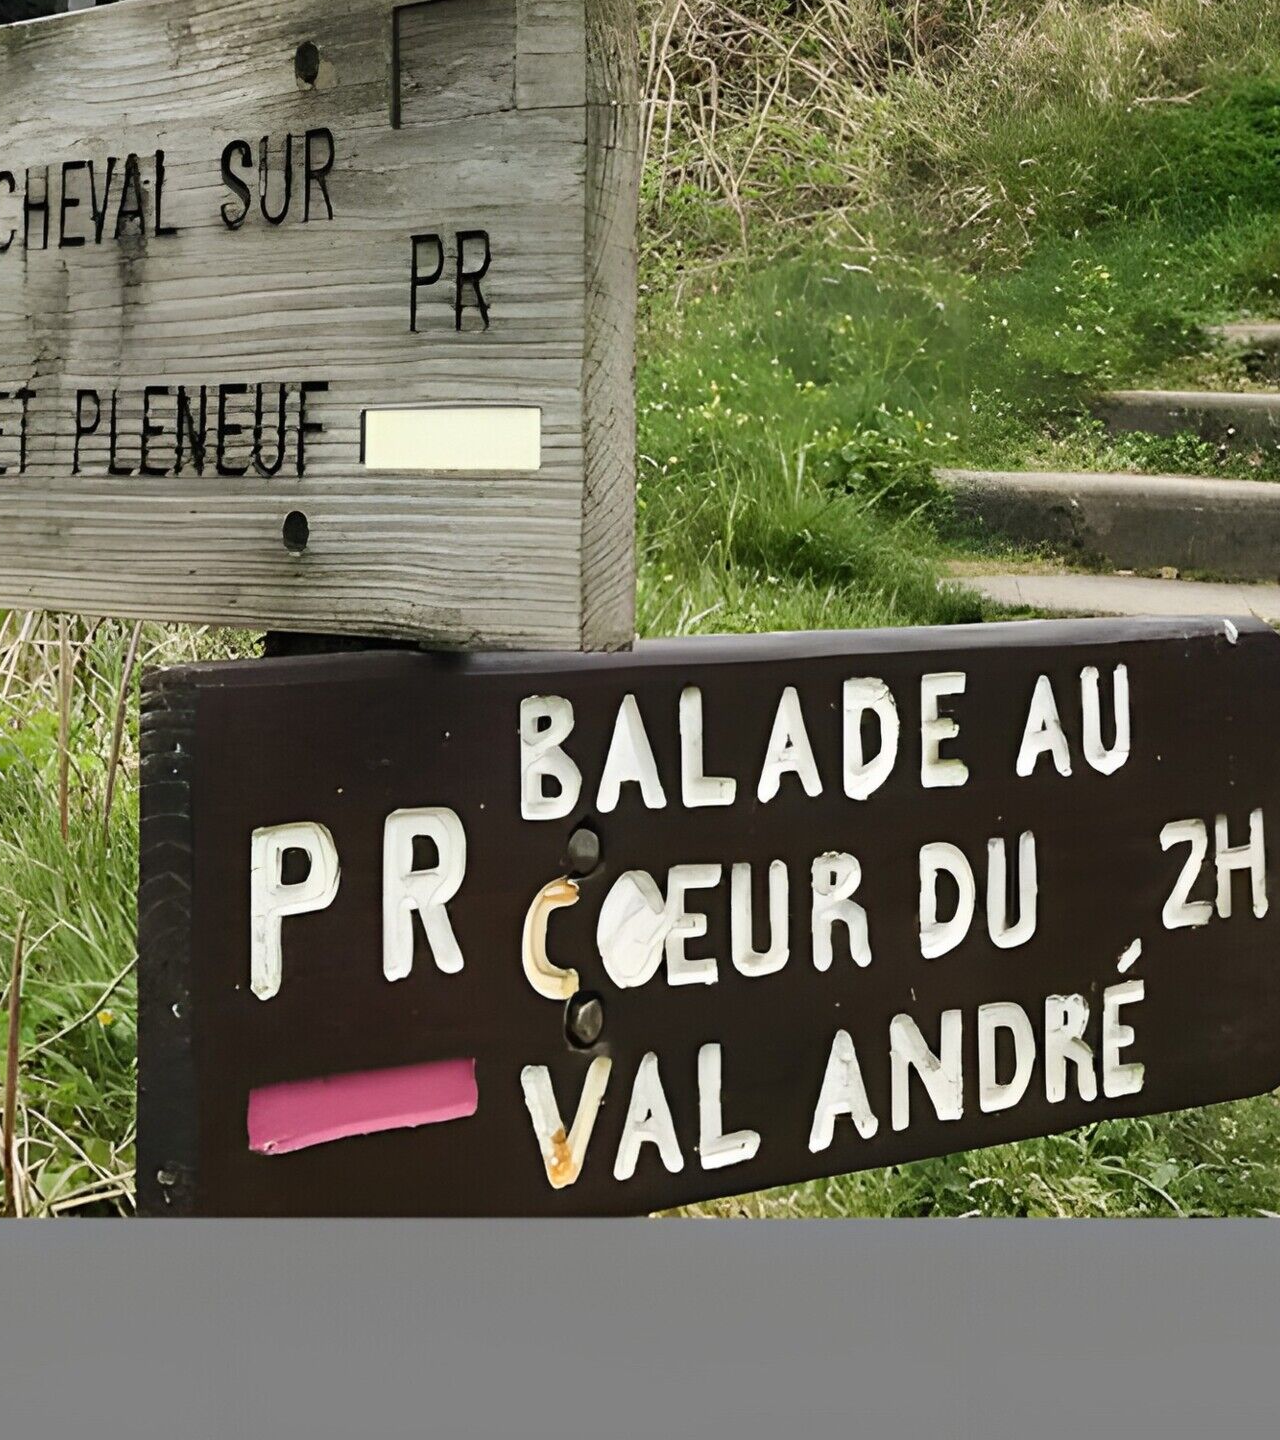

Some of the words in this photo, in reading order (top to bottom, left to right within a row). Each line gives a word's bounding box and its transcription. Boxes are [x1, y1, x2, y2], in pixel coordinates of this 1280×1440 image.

[220, 126, 336, 231] SUR
[408, 229, 492, 332] PR
[70, 380, 330, 479] PLENEUF
[518, 670, 970, 822] BALADE
[1015, 663, 1131, 778] AU
[918, 830, 1038, 960] DU
[520, 1043, 762, 1190] VAL
[808, 938, 1147, 1155] ANDRÉ
